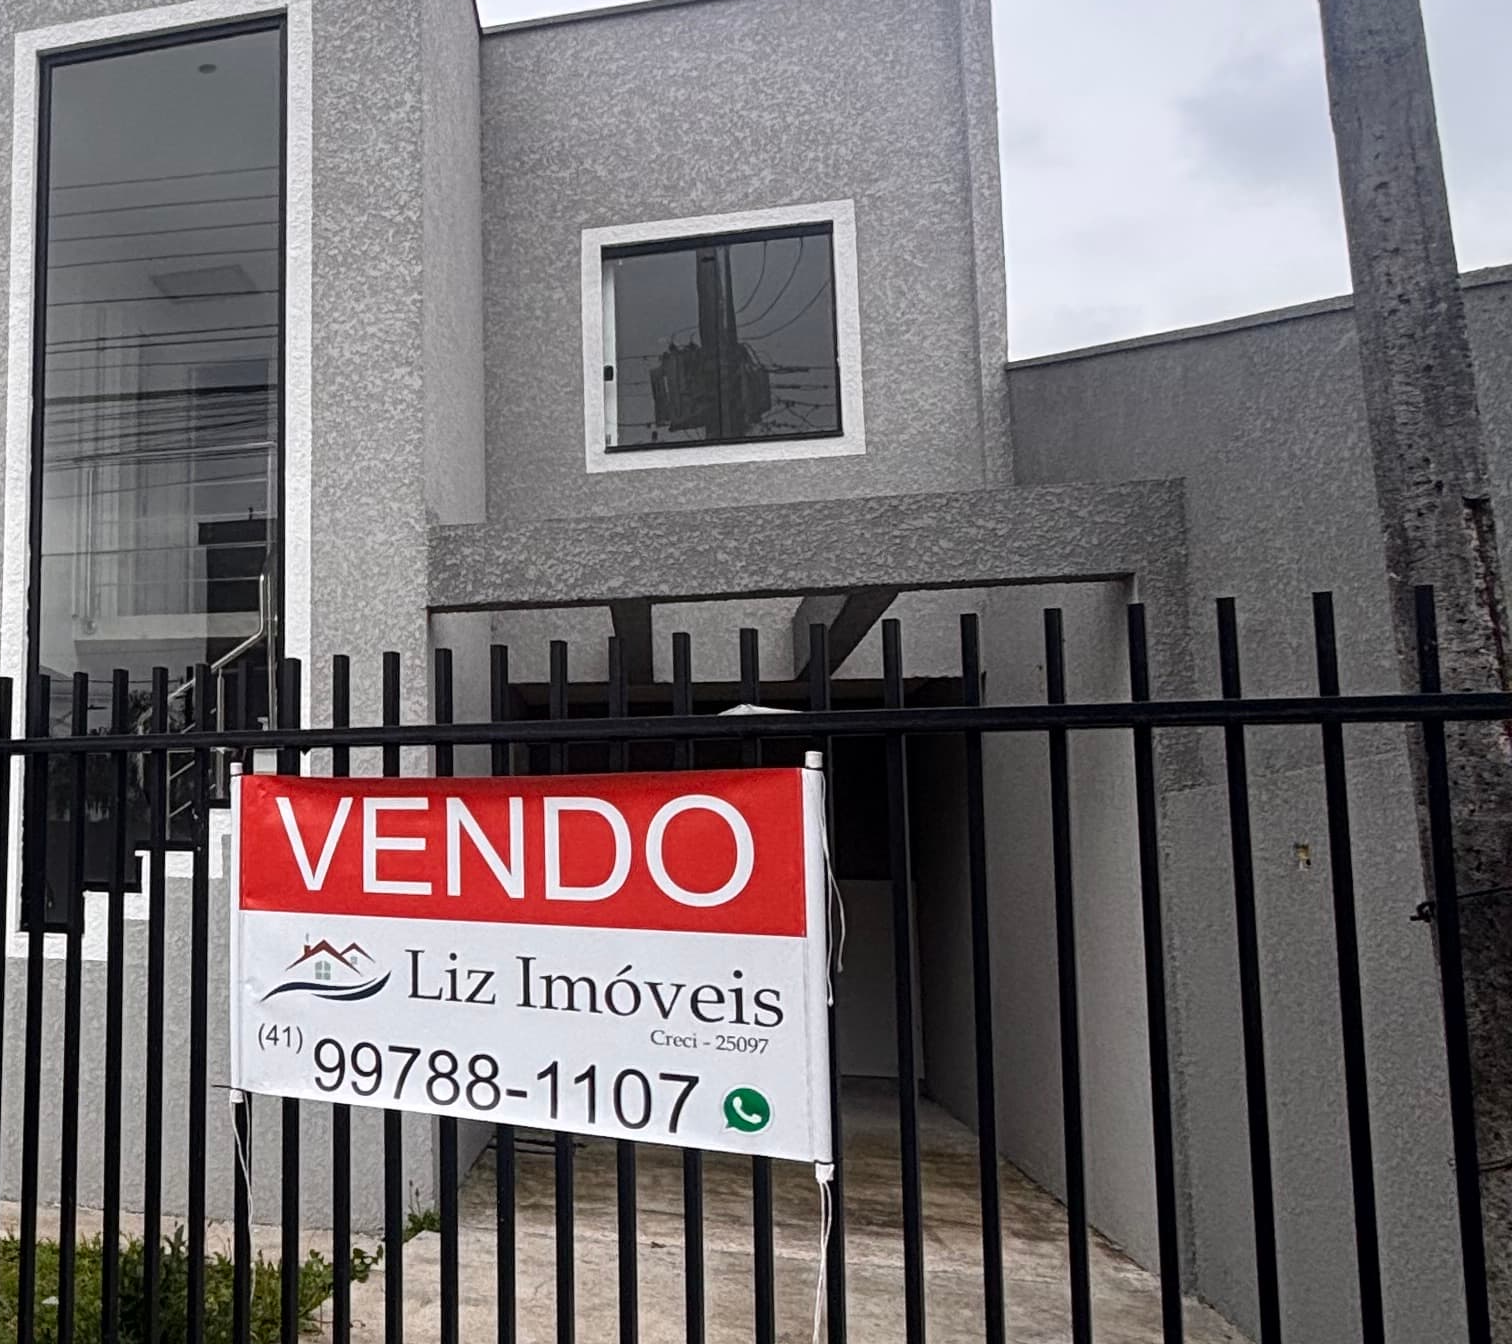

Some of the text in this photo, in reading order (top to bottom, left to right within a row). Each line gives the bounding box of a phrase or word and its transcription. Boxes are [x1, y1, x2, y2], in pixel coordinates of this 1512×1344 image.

[275, 793, 756, 908] VENDO
[405, 948, 785, 1029] Liz Imóveis
[257, 1023, 701, 1135] (41) 99788-1107
[650, 1029, 699, 1049] Creci
[715, 1034, 770, 1054] 25097
